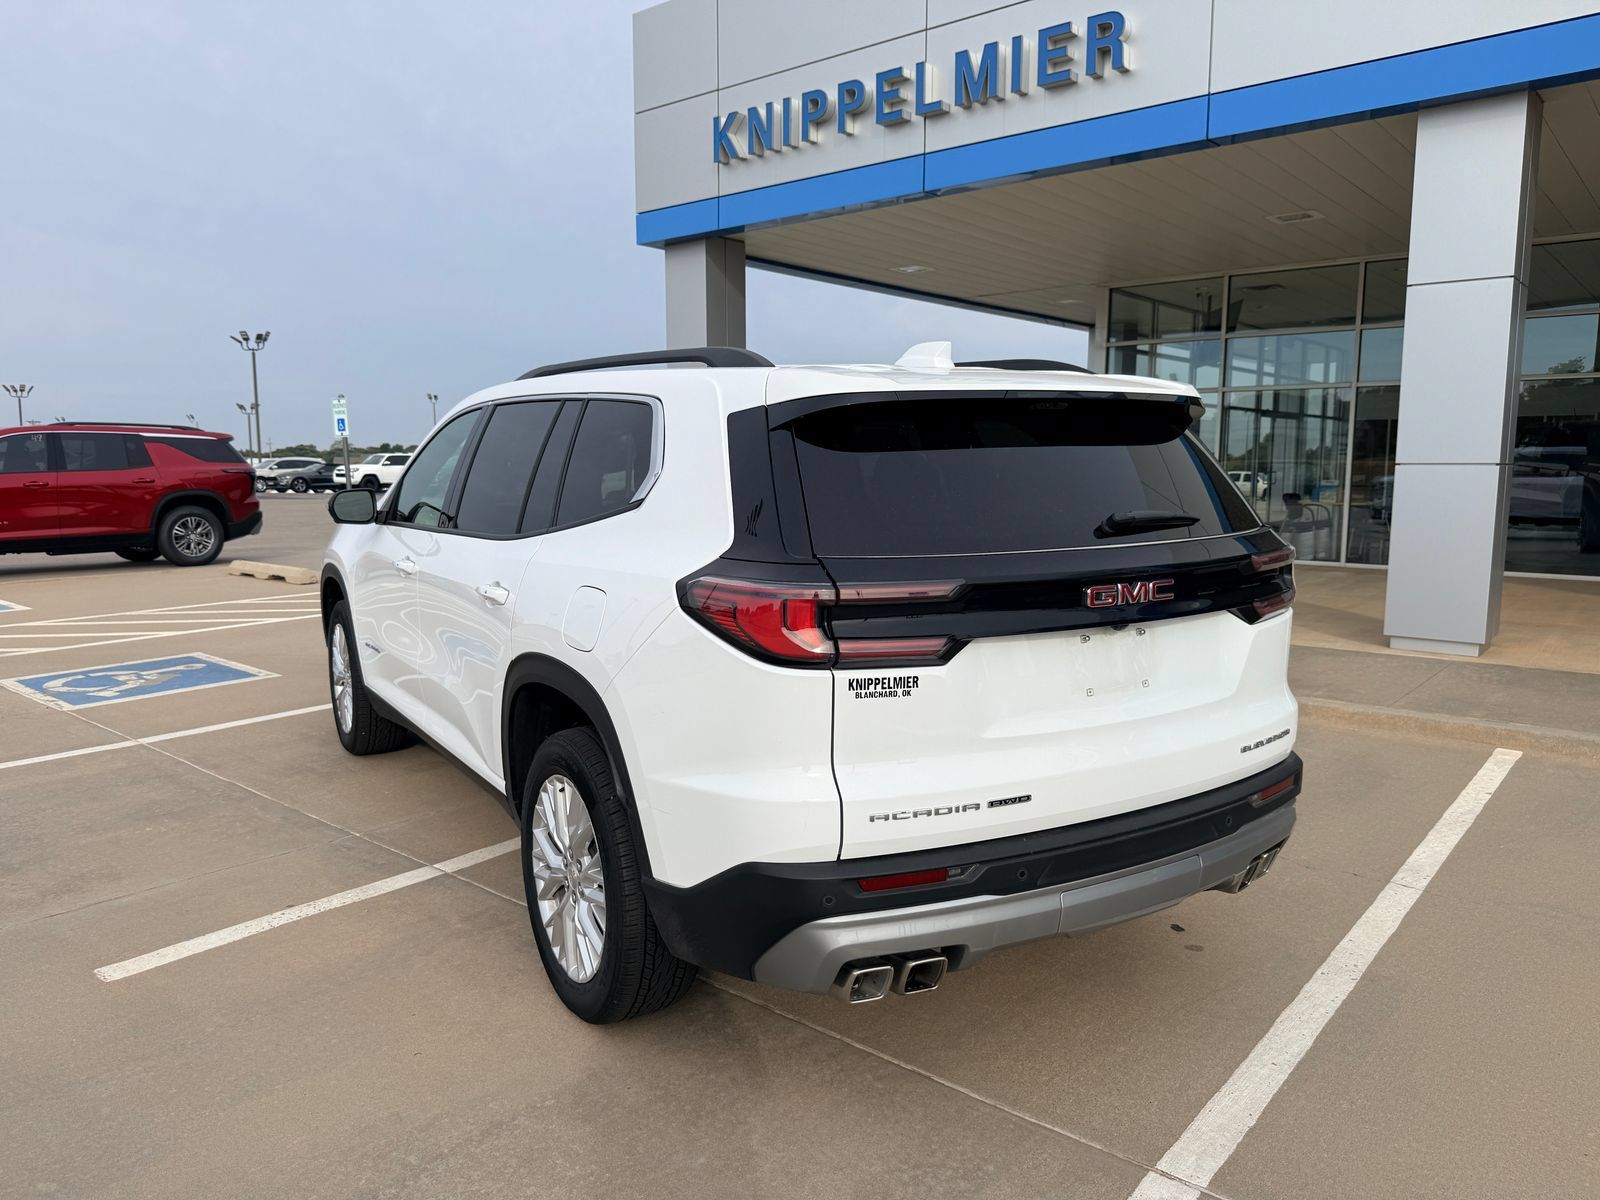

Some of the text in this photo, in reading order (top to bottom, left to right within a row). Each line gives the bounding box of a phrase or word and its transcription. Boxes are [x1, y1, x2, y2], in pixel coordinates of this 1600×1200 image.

[713, 10, 1131, 165] KNIPPELMIER
[1086, 578, 1175, 608] GMC
[848, 676, 920, 691] KNIPPELMIER
[855, 689, 912, 699] BLANCHARD, OK
[869, 803, 981, 822] ACADIA
